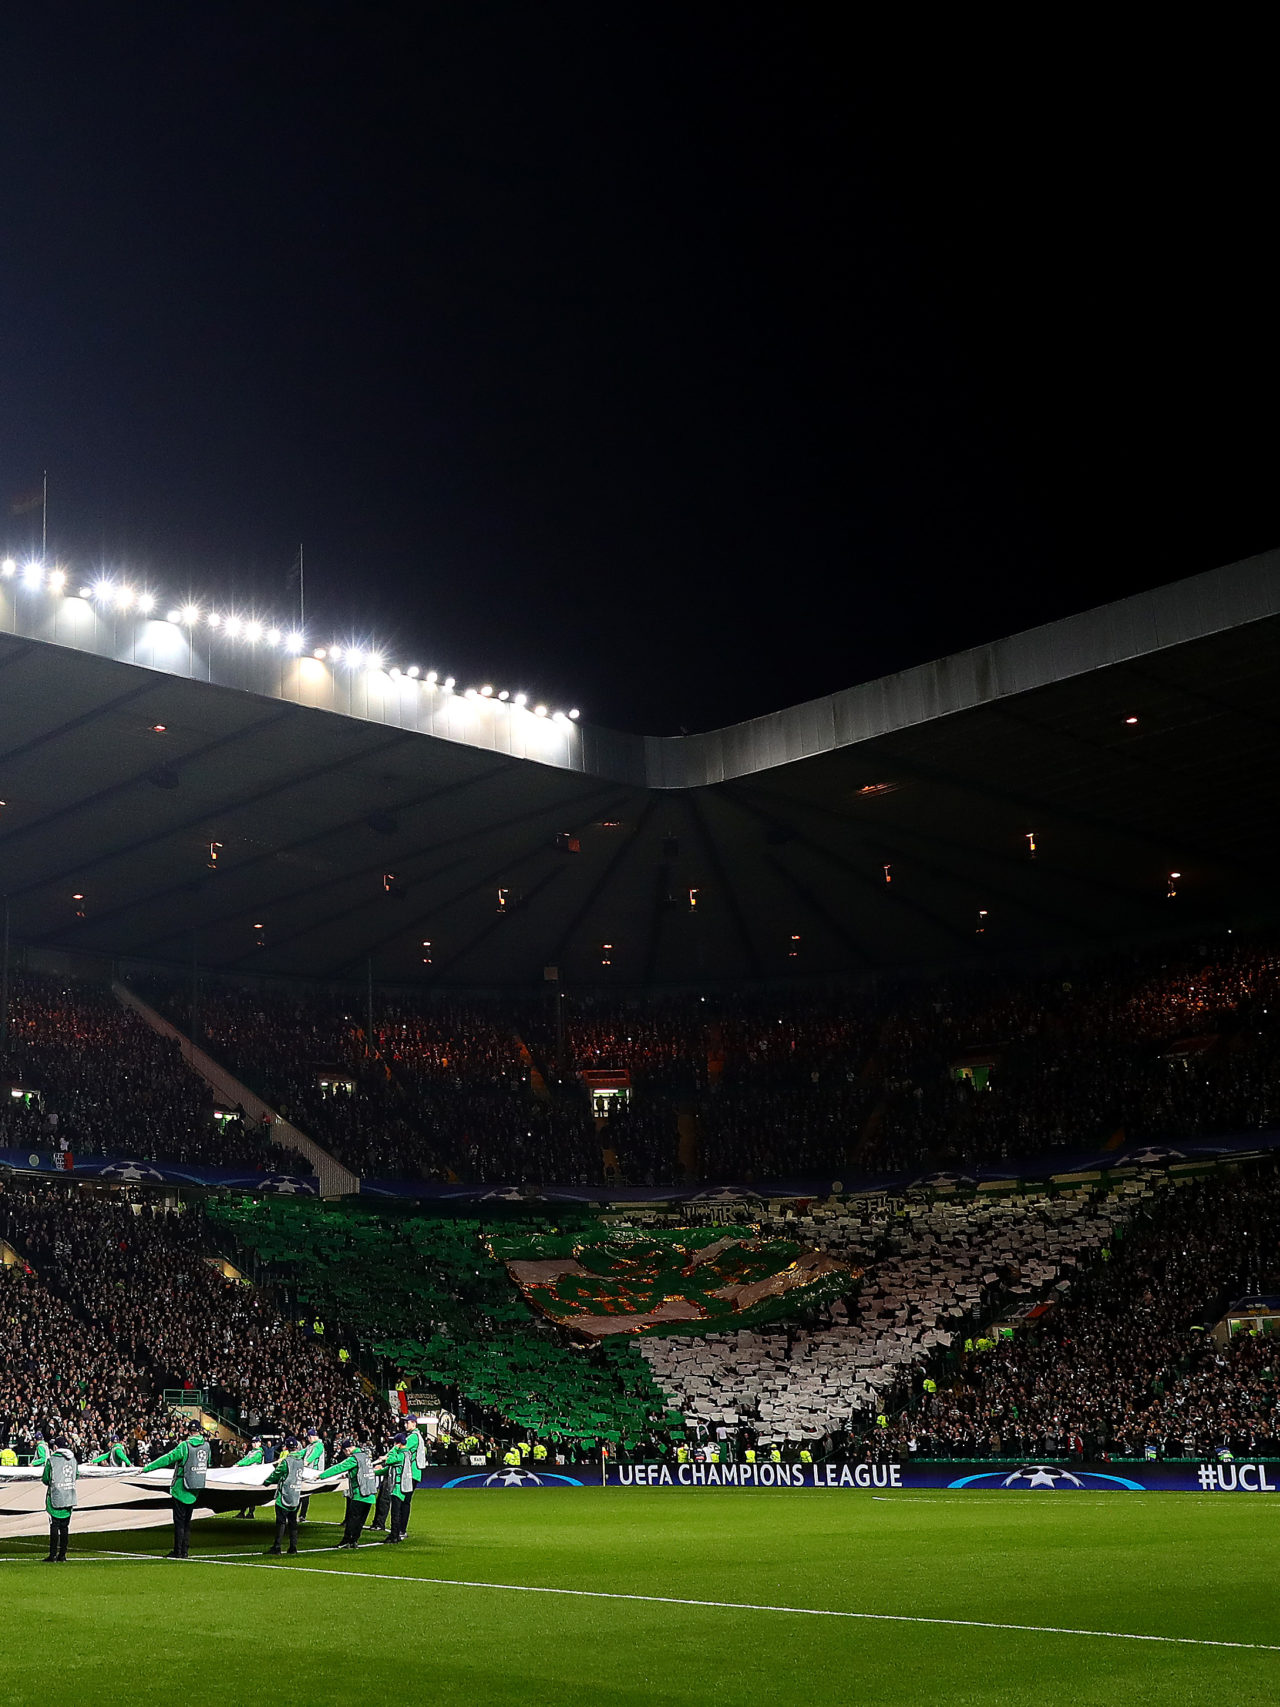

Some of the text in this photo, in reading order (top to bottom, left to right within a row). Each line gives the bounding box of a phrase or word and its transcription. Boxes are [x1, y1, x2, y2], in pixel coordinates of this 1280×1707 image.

[619, 1464, 903, 1487] UEFA CHAMPIONS LEAGUE
[1198, 1464, 1276, 1491] #UCL
